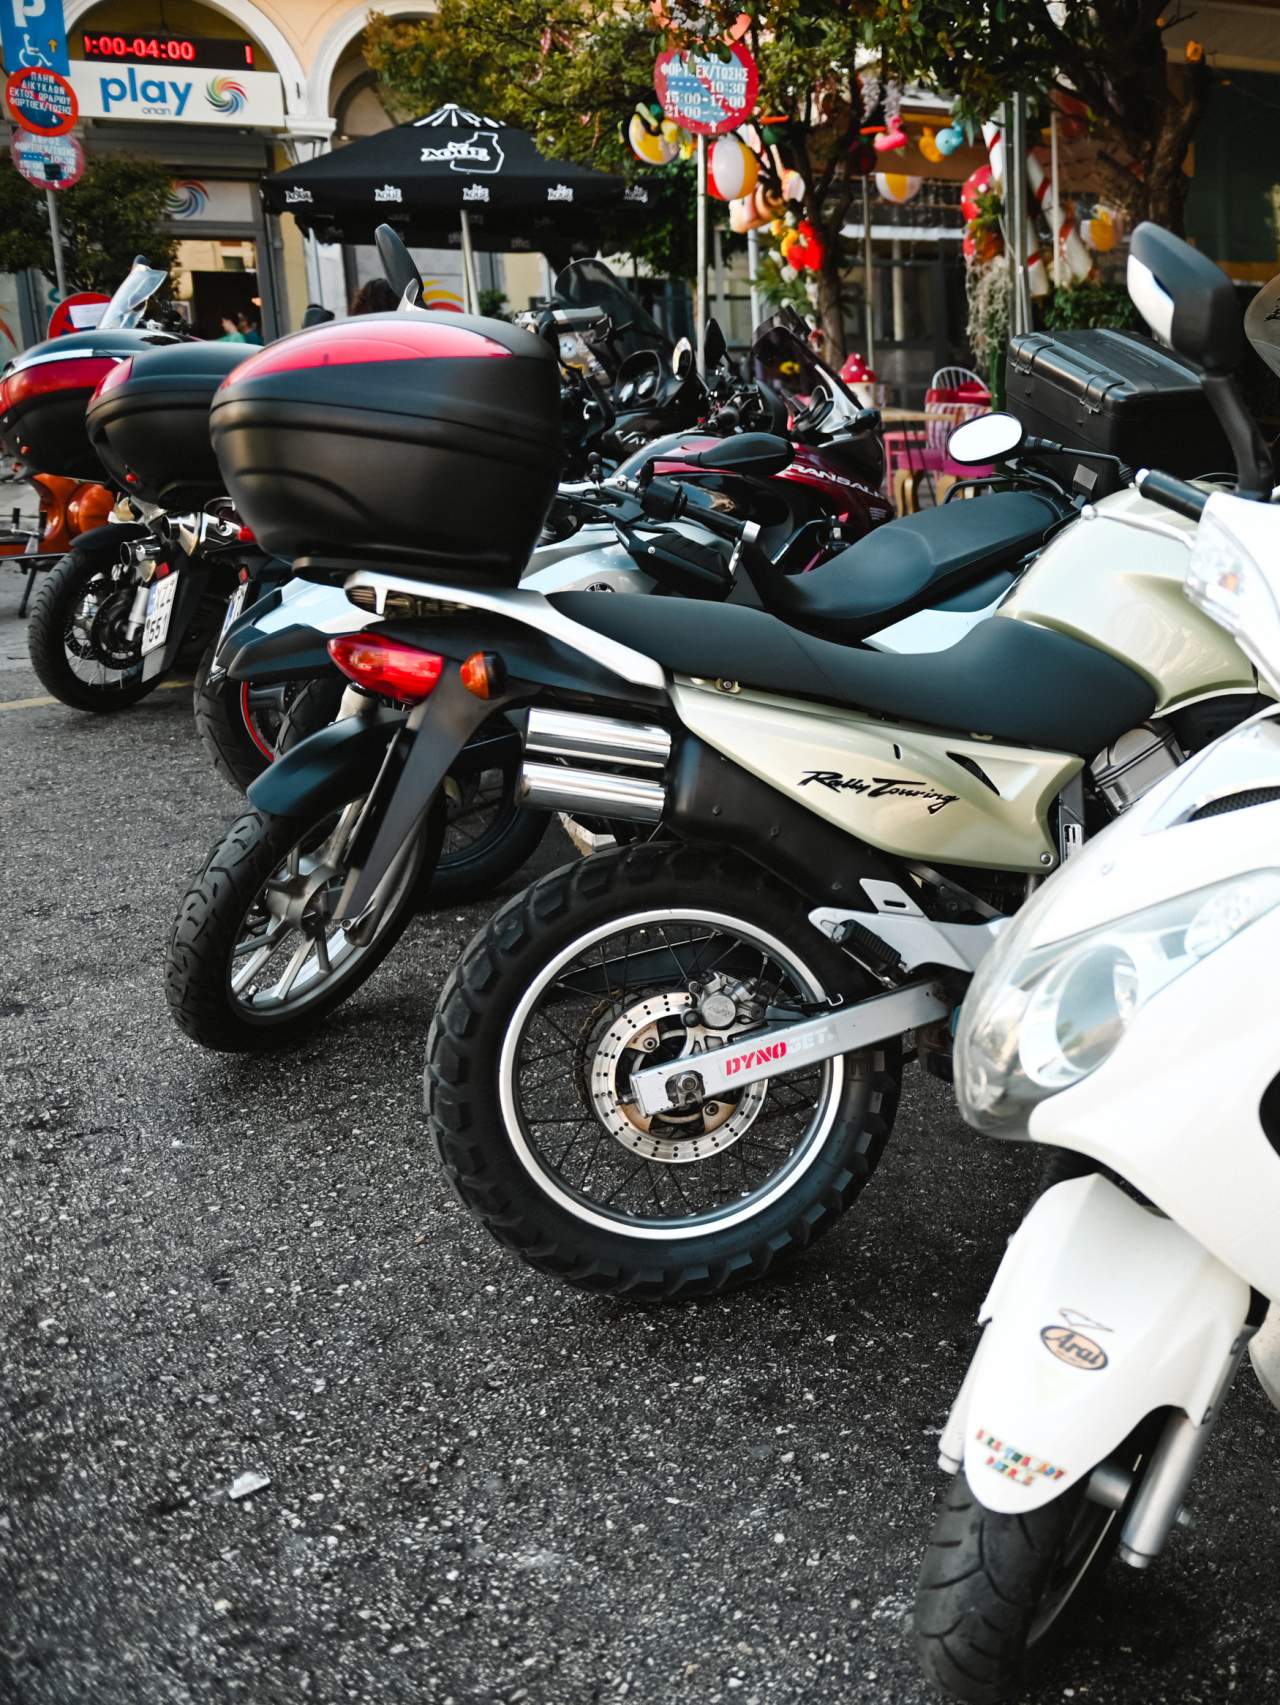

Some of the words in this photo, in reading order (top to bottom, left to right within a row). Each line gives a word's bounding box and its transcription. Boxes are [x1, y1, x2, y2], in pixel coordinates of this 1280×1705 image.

[12, 0, 46, 28] P
[660, 62, 749, 81] ΦΟΡΤΕΚ/ΤΩΣΗΣ
[100, 67, 192, 116] play
[664, 90, 746, 108] 15:00-17:00
[797, 770, 871, 794] Rally
[867, 777, 960, 815] Touring
[1045, 1333, 1102, 1365] Arai
